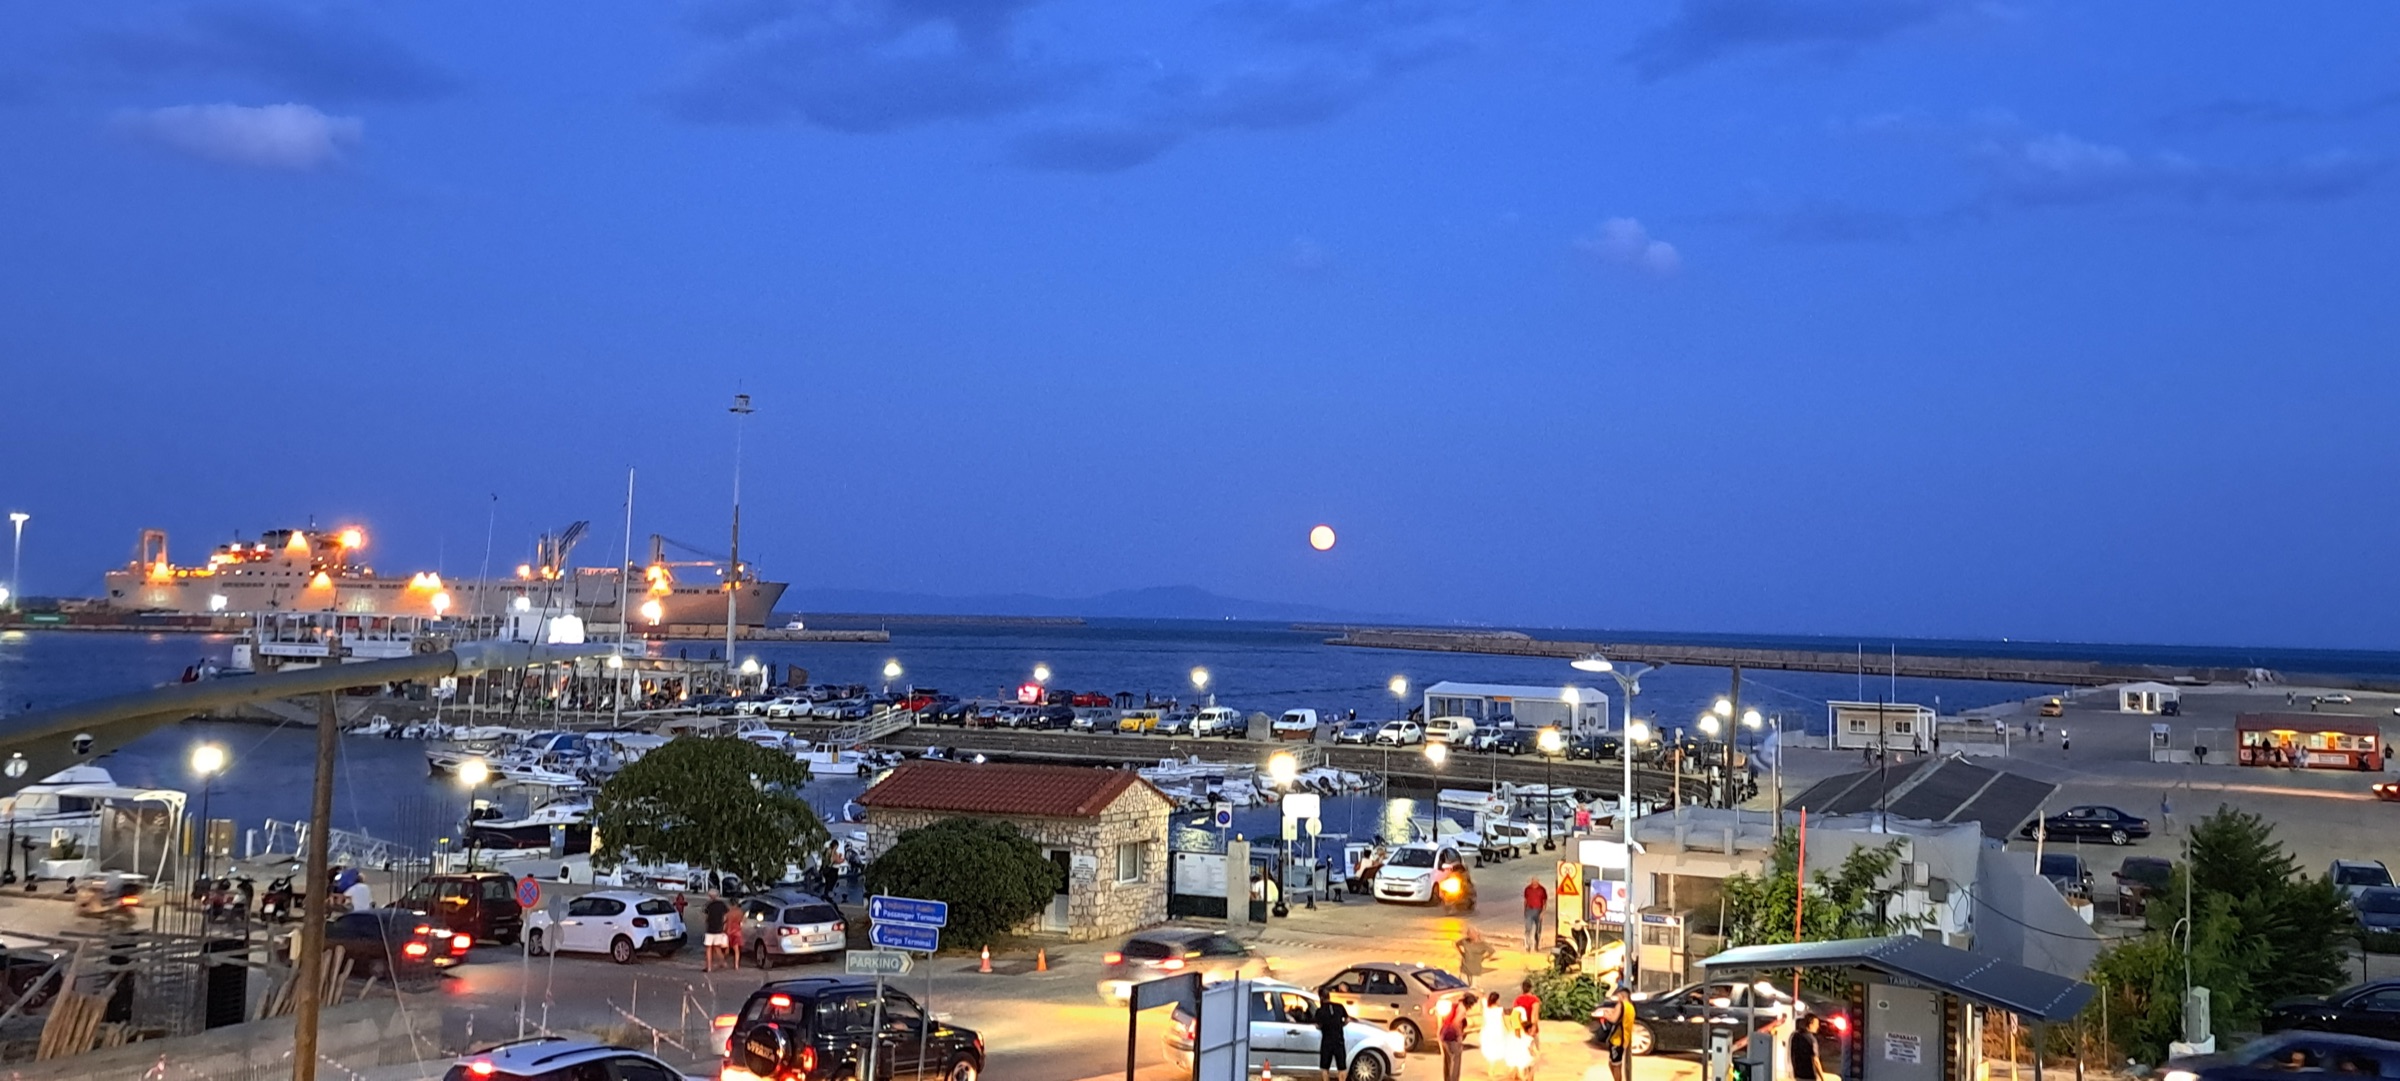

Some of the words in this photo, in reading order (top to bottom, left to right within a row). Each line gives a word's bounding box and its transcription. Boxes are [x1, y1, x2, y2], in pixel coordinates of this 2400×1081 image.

[917, 913, 943, 923] Terminal
[883, 935, 902, 946] Cargo
[904, 937, 932, 947] Terminal
[849, 956, 900, 969] PARKING
